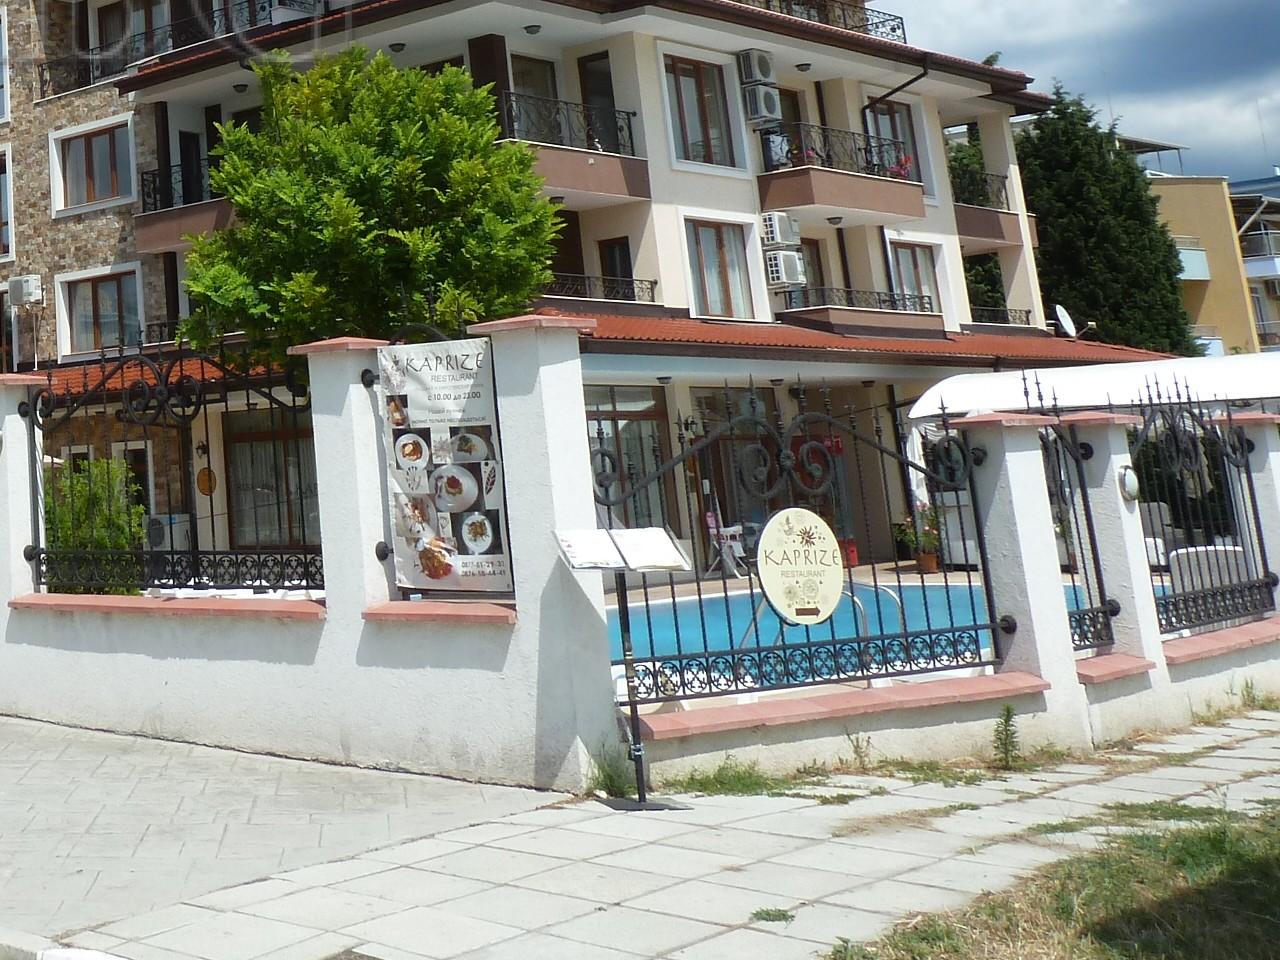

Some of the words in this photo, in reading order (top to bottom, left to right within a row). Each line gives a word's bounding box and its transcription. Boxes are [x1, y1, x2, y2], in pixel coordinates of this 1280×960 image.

[406, 352, 483, 372] KAPRIZE
[431, 373, 478, 382] RESTAURANT
[764, 548, 839, 567] KAPRIZE
[781, 570, 825, 578] RESTAURANT
